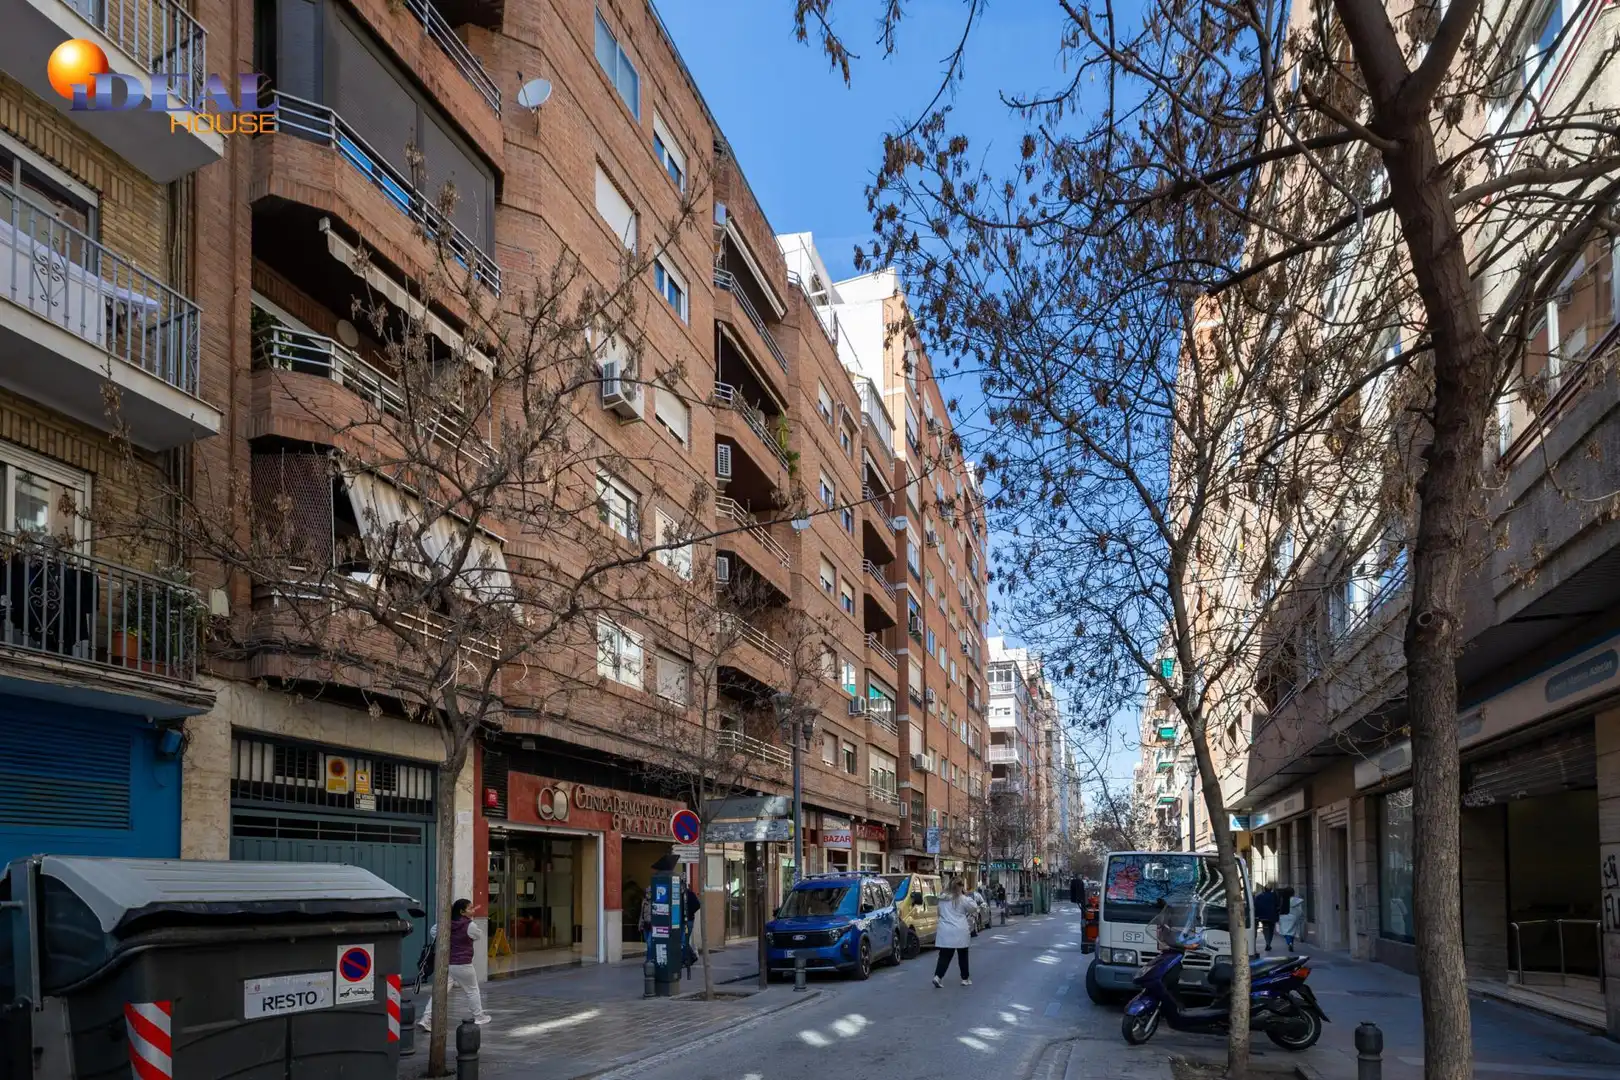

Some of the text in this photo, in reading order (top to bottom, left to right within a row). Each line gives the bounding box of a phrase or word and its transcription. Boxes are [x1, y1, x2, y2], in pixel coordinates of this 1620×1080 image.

[611, 813, 673, 836] GRANAD
[823, 835, 851, 843] BAZAR
[1125, 932, 1141, 941] SP
[262, 991, 318, 1012] RESTO
